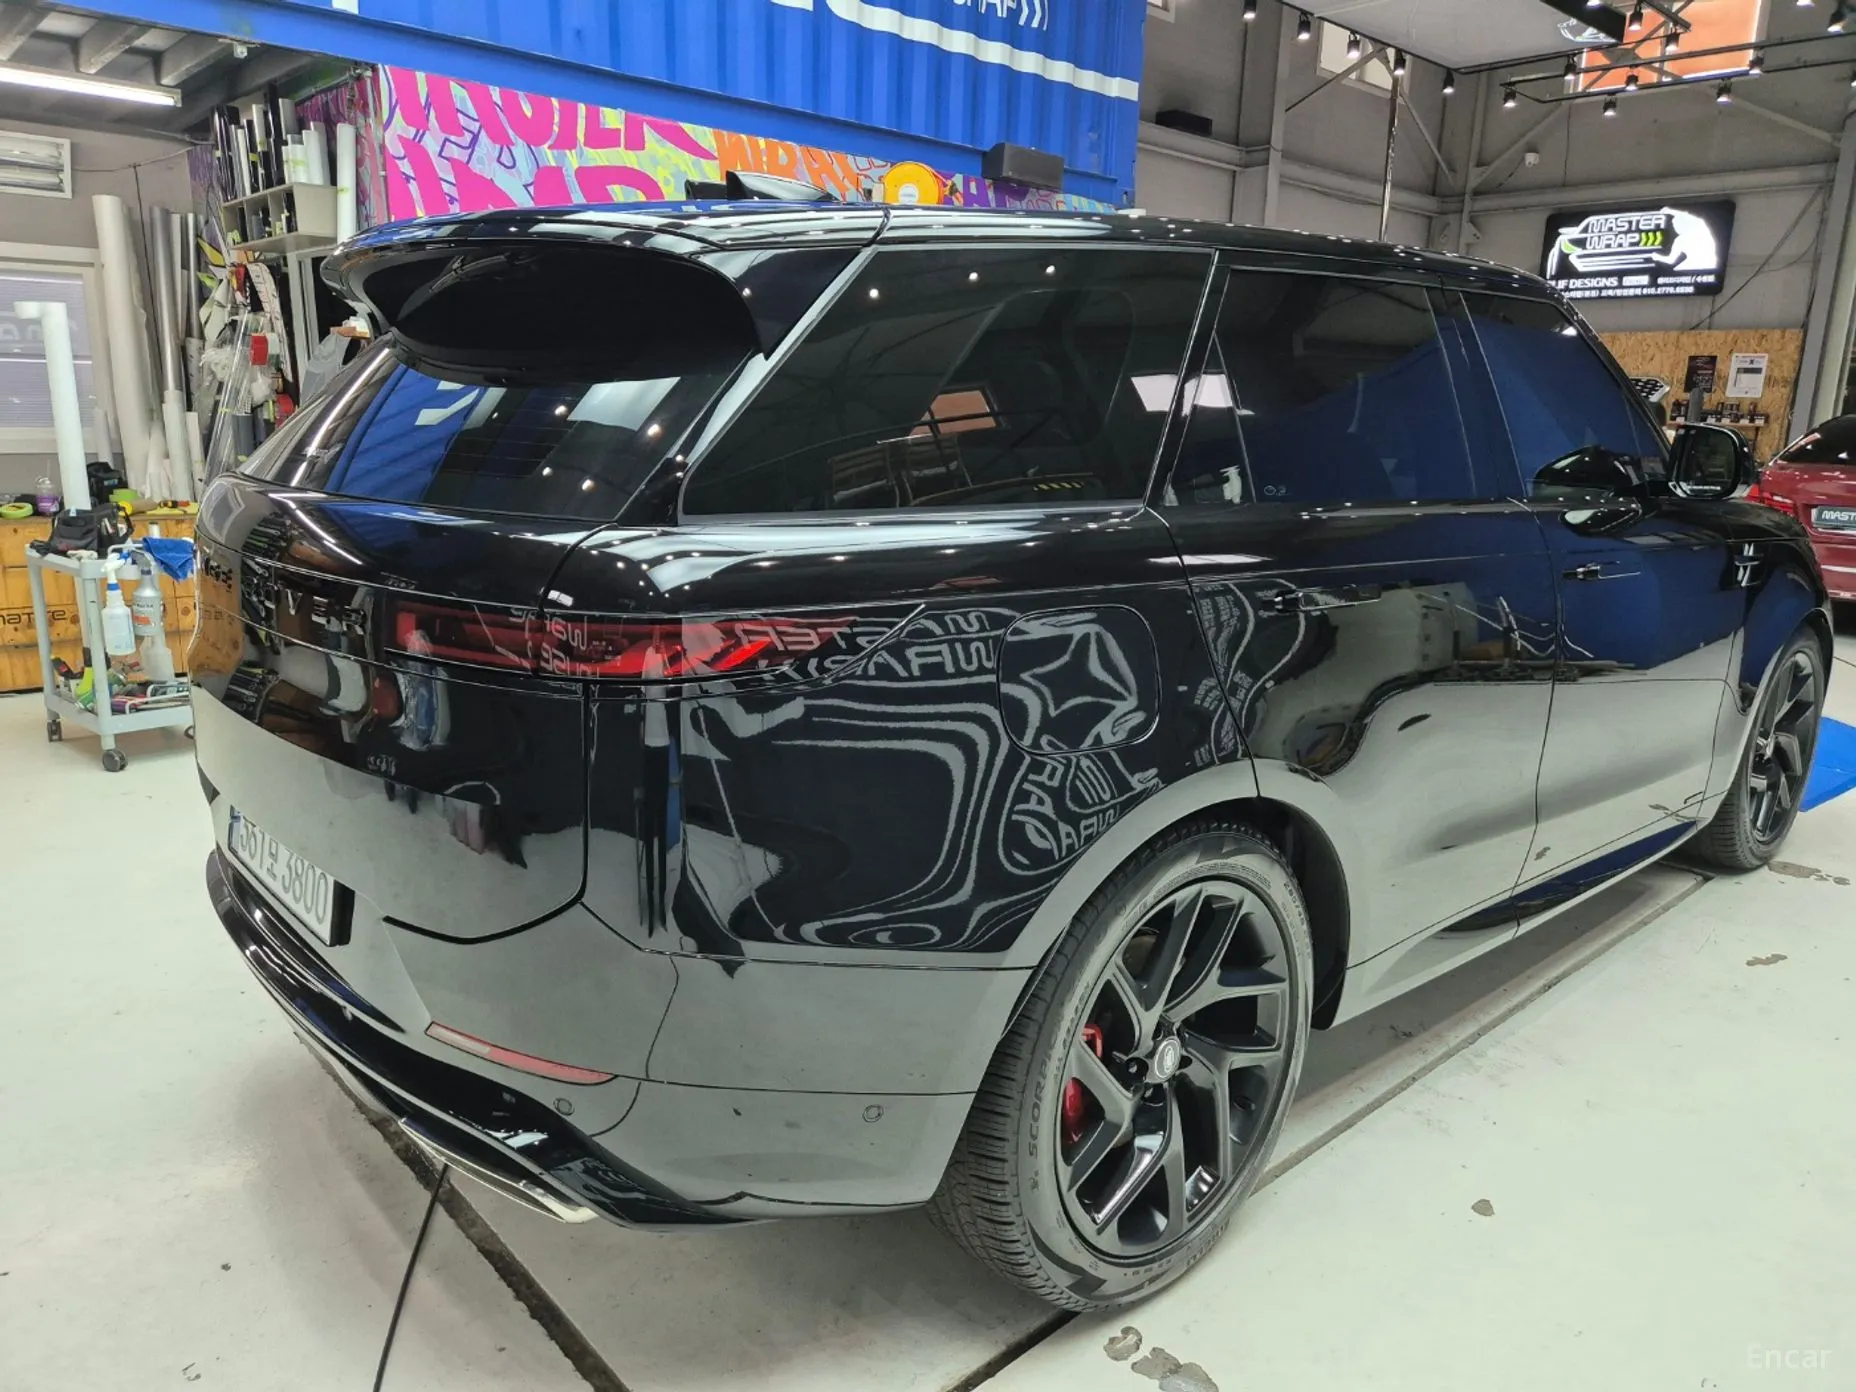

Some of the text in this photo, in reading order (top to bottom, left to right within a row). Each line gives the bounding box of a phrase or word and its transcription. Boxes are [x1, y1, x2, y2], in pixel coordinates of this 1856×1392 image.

[1588, 214, 1667, 233] MASTER
[1586, 232, 1640, 249] WRAP
[1569, 277, 1619, 289] DESIGNS
[281, 848, 329, 925] 3800
